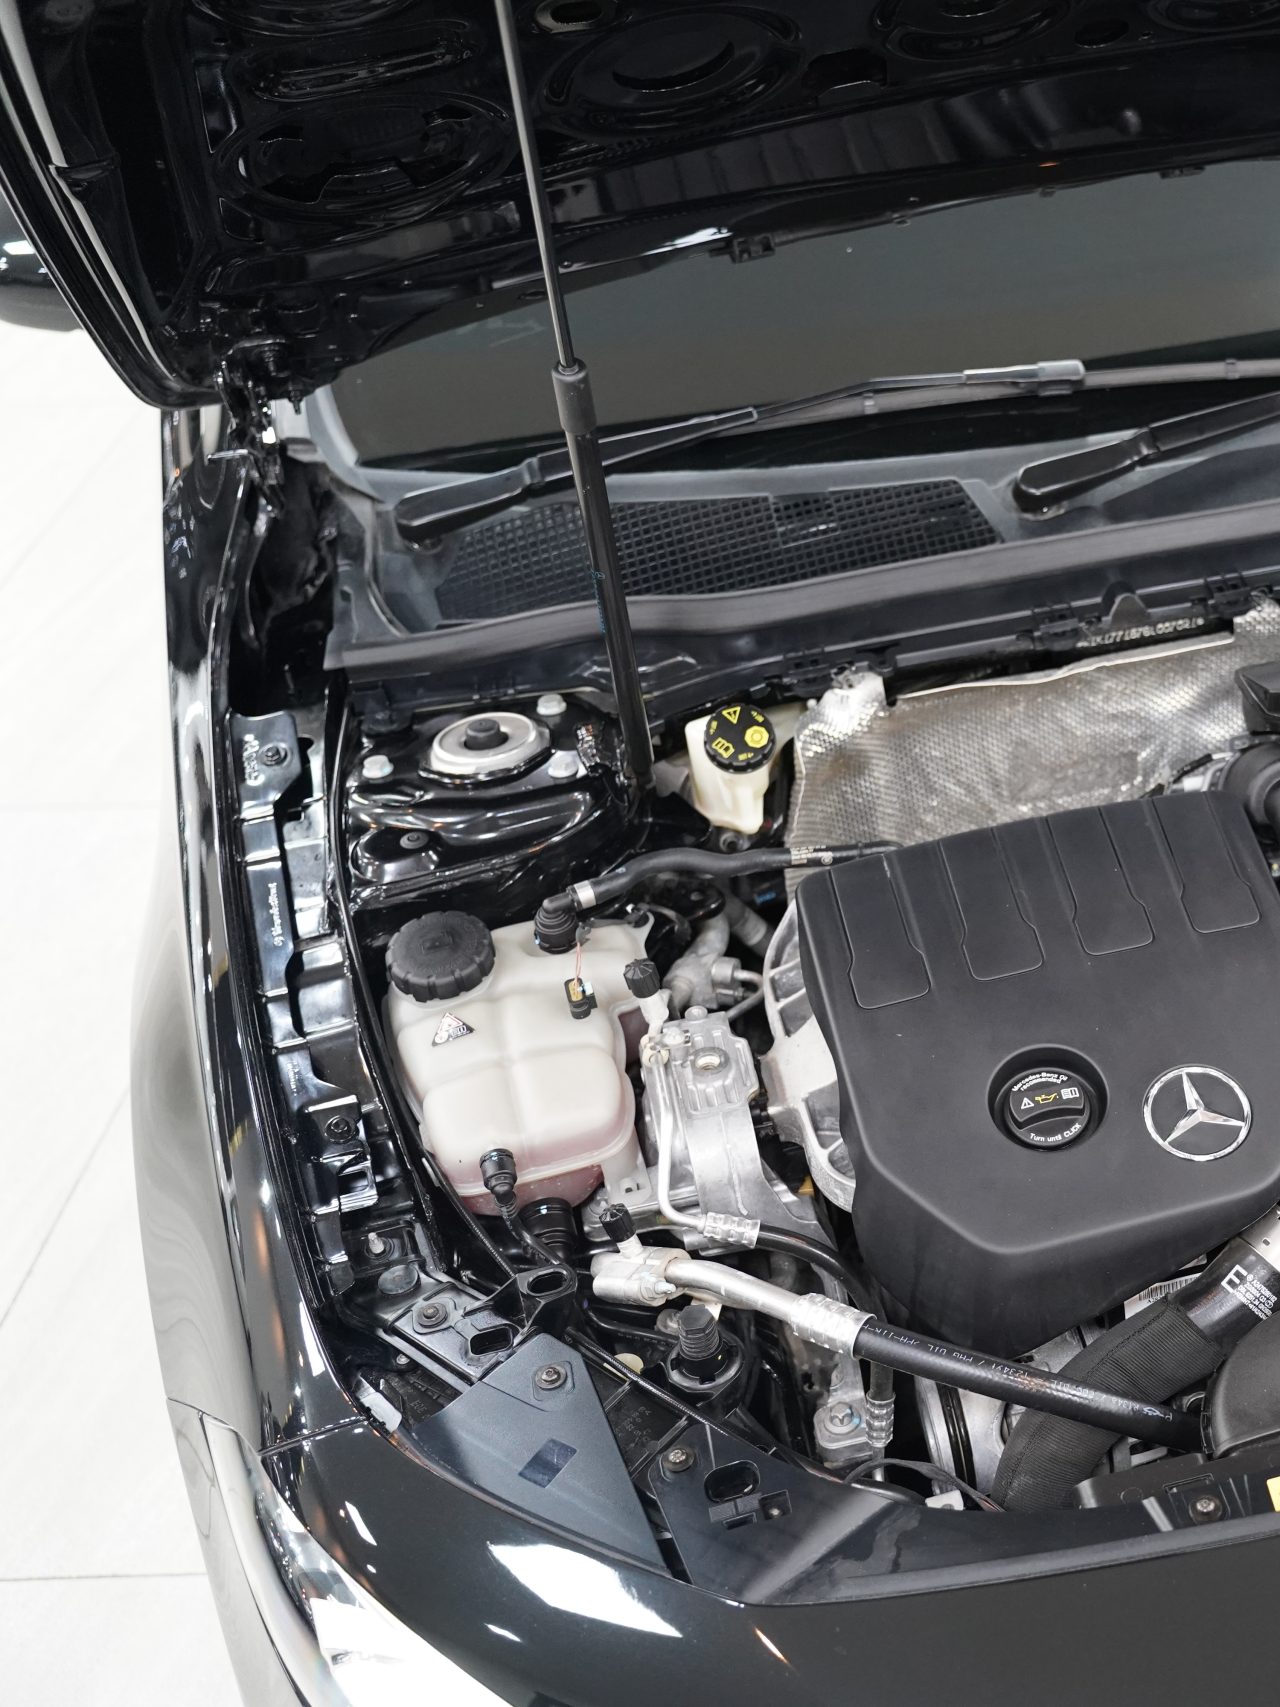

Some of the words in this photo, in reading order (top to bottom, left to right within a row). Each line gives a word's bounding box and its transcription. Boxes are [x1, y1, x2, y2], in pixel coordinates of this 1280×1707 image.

[1030, 1132, 1045, 1142] Turn
[1047, 1134, 1062, 1142] until
[1063, 1122, 1081, 1138] CLICK
[1221, 1264, 1248, 1293] E
